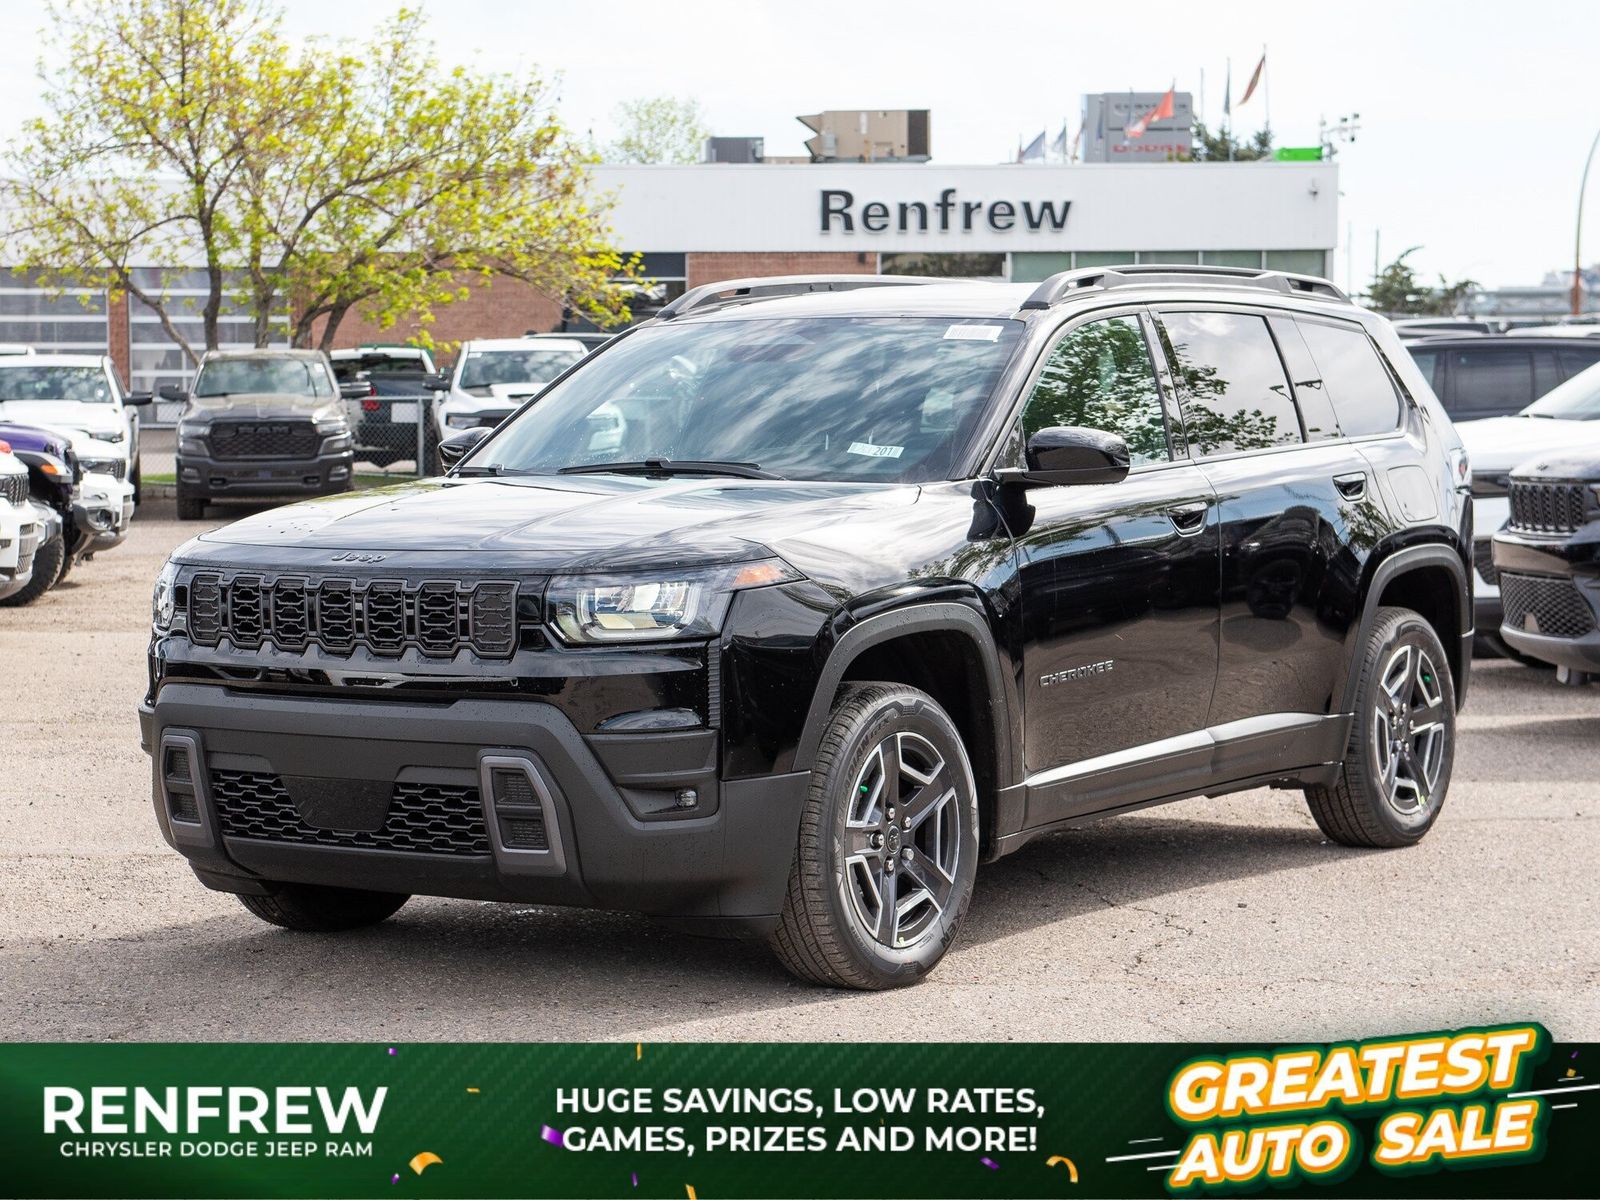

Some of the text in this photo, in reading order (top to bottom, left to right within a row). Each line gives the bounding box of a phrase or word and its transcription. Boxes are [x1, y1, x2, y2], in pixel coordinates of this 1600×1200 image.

[820, 189, 1072, 233] Renfrew
[330, 551, 386, 564] Jeep
[1039, 659, 1113, 687] CHEROKEE
